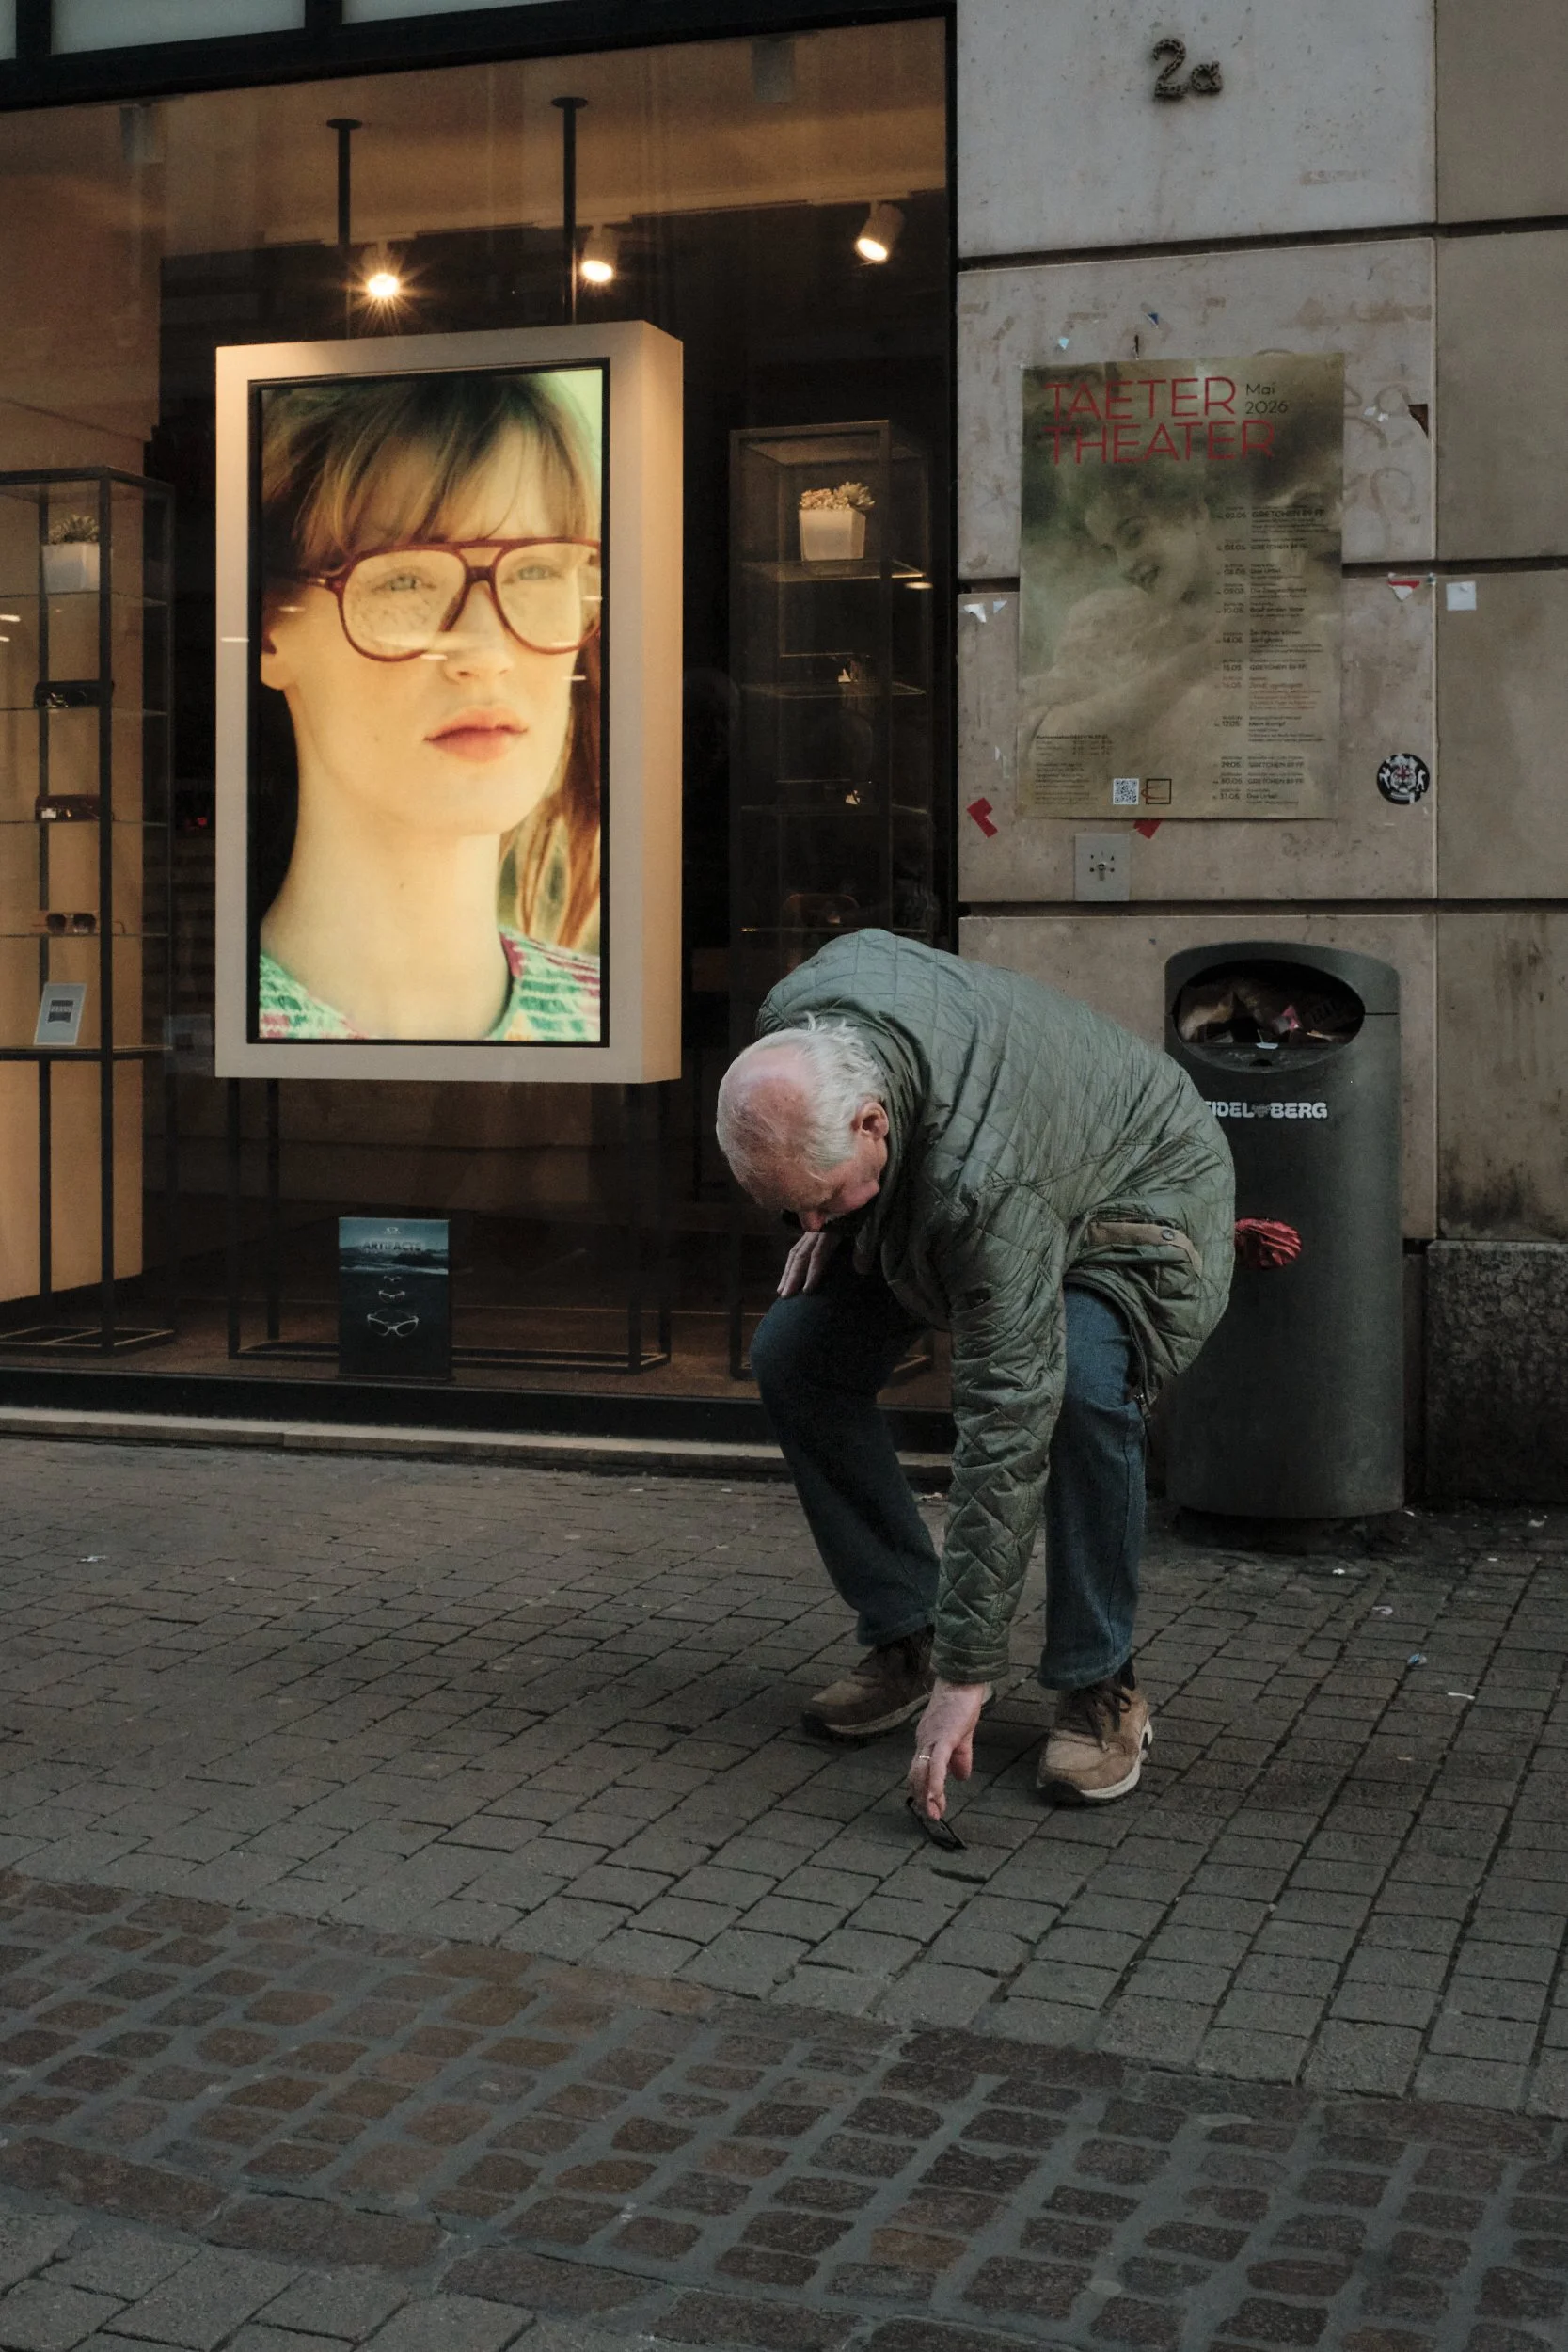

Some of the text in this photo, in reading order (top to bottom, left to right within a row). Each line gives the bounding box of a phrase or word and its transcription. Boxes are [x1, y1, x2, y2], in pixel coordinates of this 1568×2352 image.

[1151, 39, 1224, 98] 2a
[1044, 376, 1237, 422] TAETER
[1245, 382, 1276, 396] Mai
[1244, 399, 1289, 415] 2026
[1041, 420, 1276, 467] THEATER
[1270, 1102, 1328, 1119] BERG
